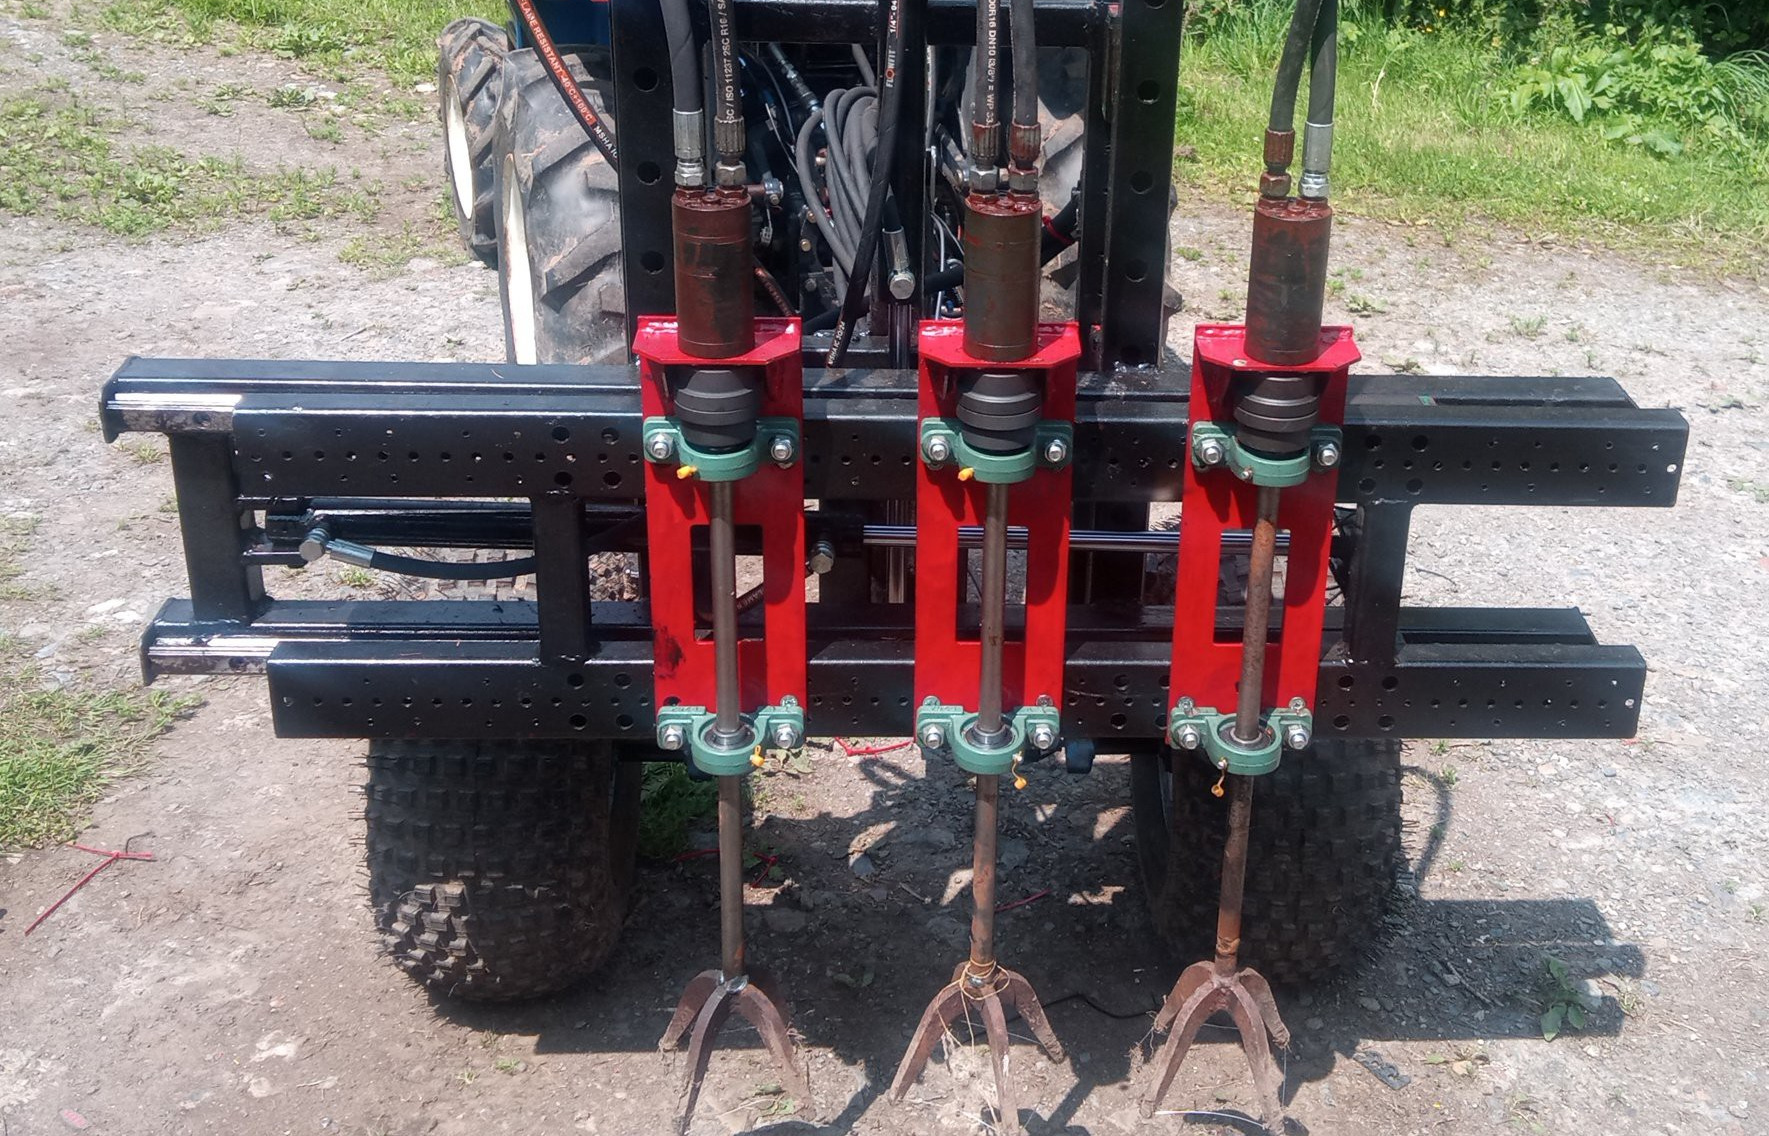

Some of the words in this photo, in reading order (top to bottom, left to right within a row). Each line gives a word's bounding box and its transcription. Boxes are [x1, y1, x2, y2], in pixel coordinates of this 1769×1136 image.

[719, 18, 729, 36] R16
[721, 38, 731, 56] 2SC
[988, 30, 997, 56] DN10
[520, 0, 538, 28] LAME
[533, 26, 563, 76] RESISTANT
[594, 125, 613, 151] MSHA
[723, 58, 733, 83] 11237
[725, 85, 734, 101] ISO
[986, 93, 994, 110] WP
